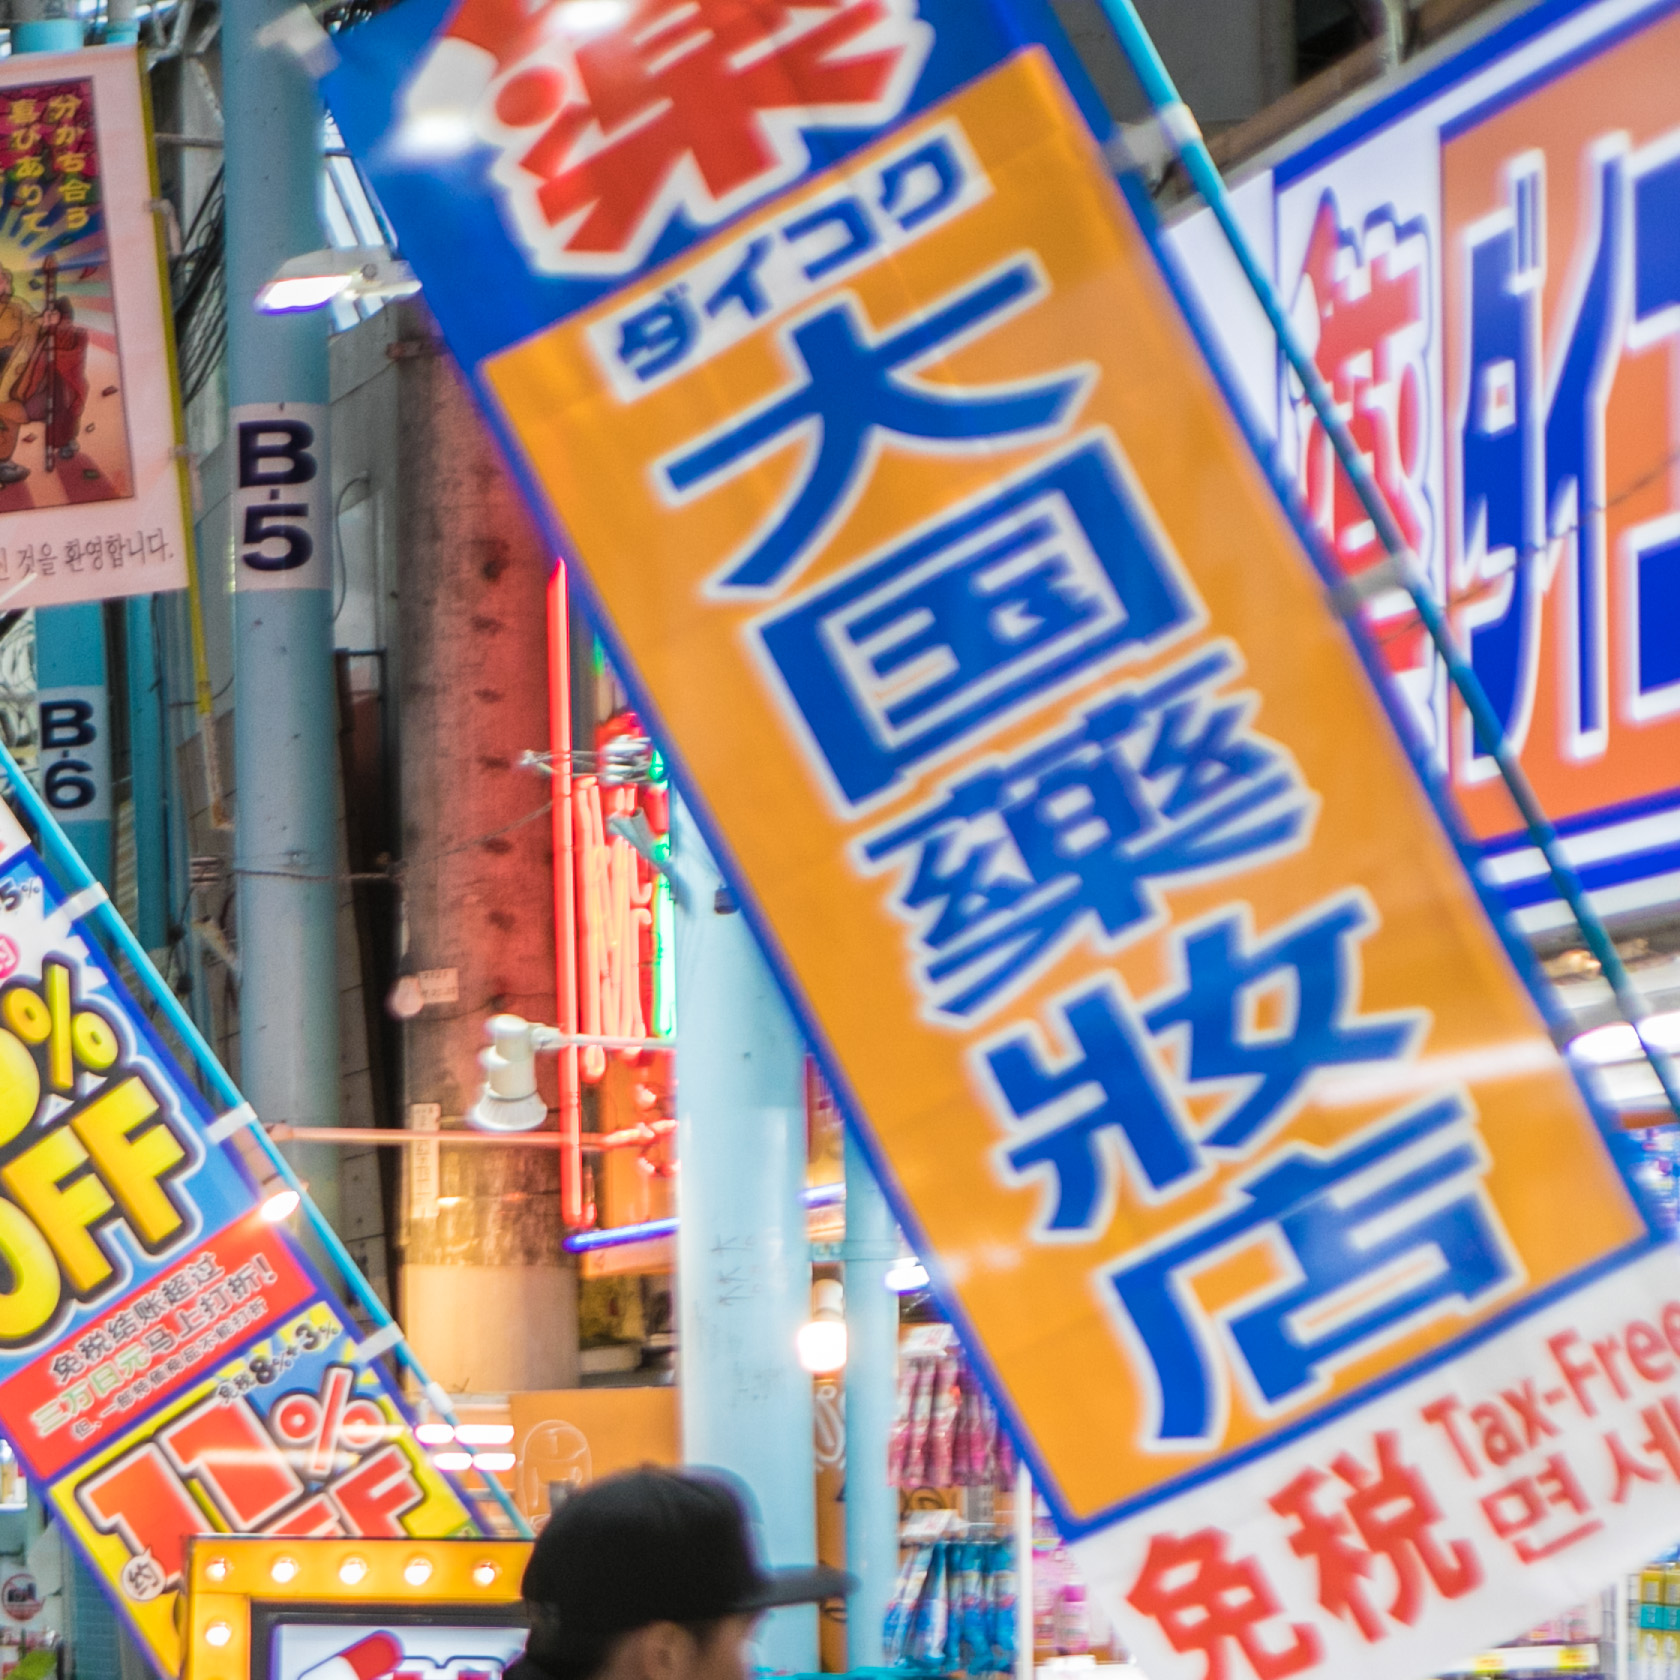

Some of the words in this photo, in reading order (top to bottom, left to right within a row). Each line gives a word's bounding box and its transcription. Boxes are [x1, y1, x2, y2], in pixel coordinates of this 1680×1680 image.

[11, 98, 50, 234] 喜びありて
[50, 93, 91, 231] 分かち合う
[616, 132, 968, 385] ダイコク
[16, 543, 60, 580] 것을
[63, 528, 176, 574] 환영합니다.
[50, 1250, 226, 1386] 免税结账超过
